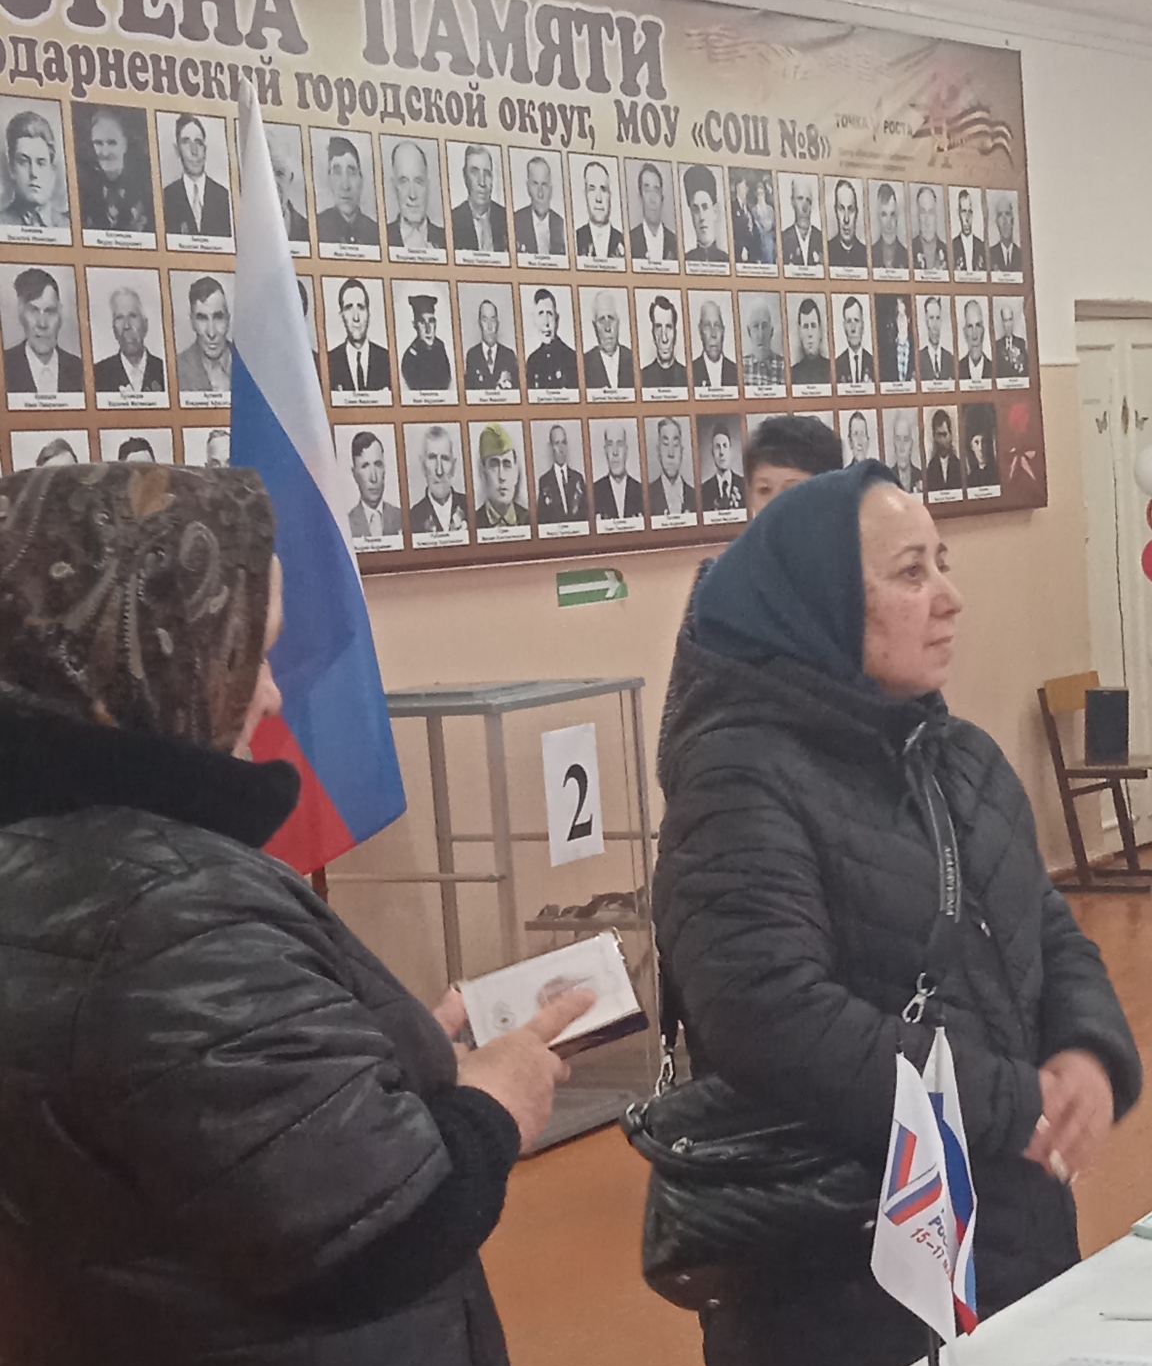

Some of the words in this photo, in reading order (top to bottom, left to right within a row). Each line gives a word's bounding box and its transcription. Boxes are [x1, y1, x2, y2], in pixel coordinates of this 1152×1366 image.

[295, 71, 488, 129] городской
[498, 96, 597, 150] округ,
[614, 98, 681, 148] МОУ
[691, 109, 772, 157] «СОШ
[883, 119, 913, 136] РОСТА
[562, 763, 593, 842] 2
